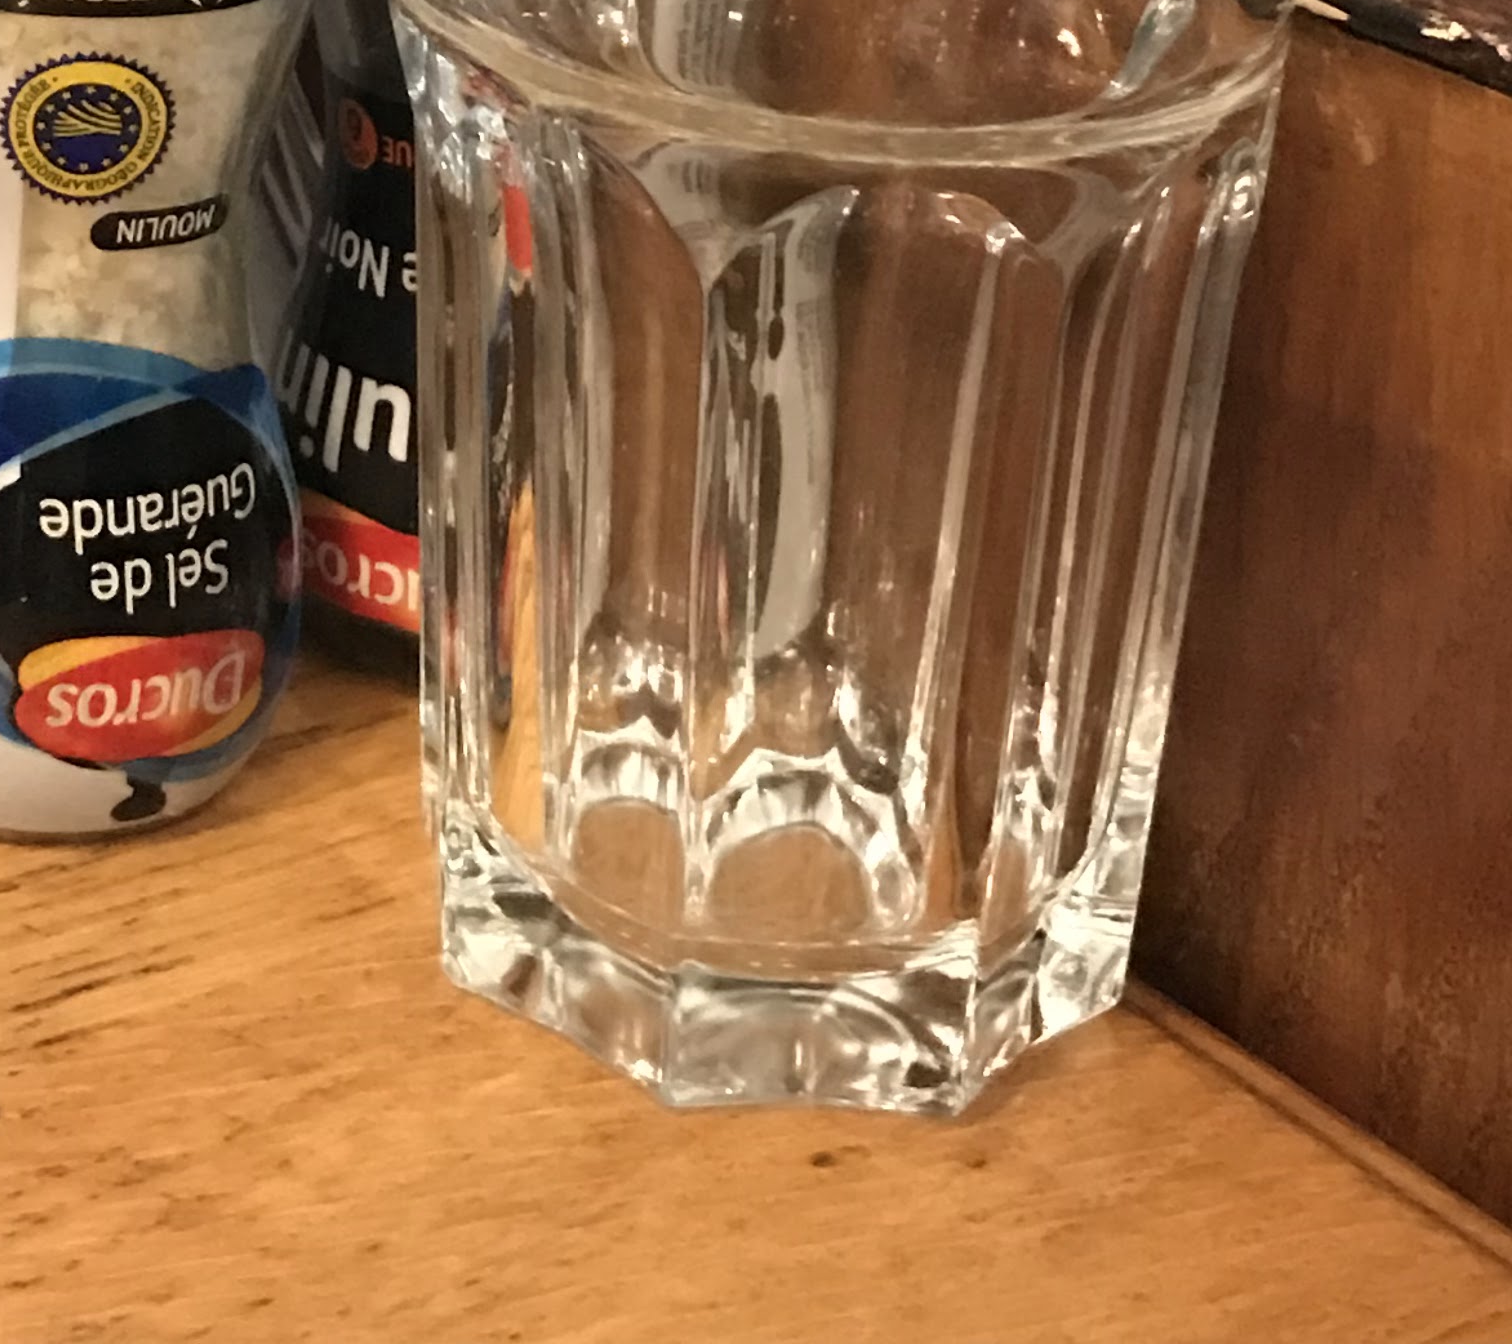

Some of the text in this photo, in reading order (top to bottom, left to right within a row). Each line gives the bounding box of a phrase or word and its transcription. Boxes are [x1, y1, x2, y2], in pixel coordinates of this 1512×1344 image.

[15, 79, 161, 192] INDICATION GÉOGRAPHIQUE PROTÉGÉE
[116, 203, 216, 244] MOULIN
[277, 329, 413, 474] ulin
[39, 462, 257, 556] Guérande
[89, 538, 229, 615] Sel de
[45, 648, 248, 729] Ducros
